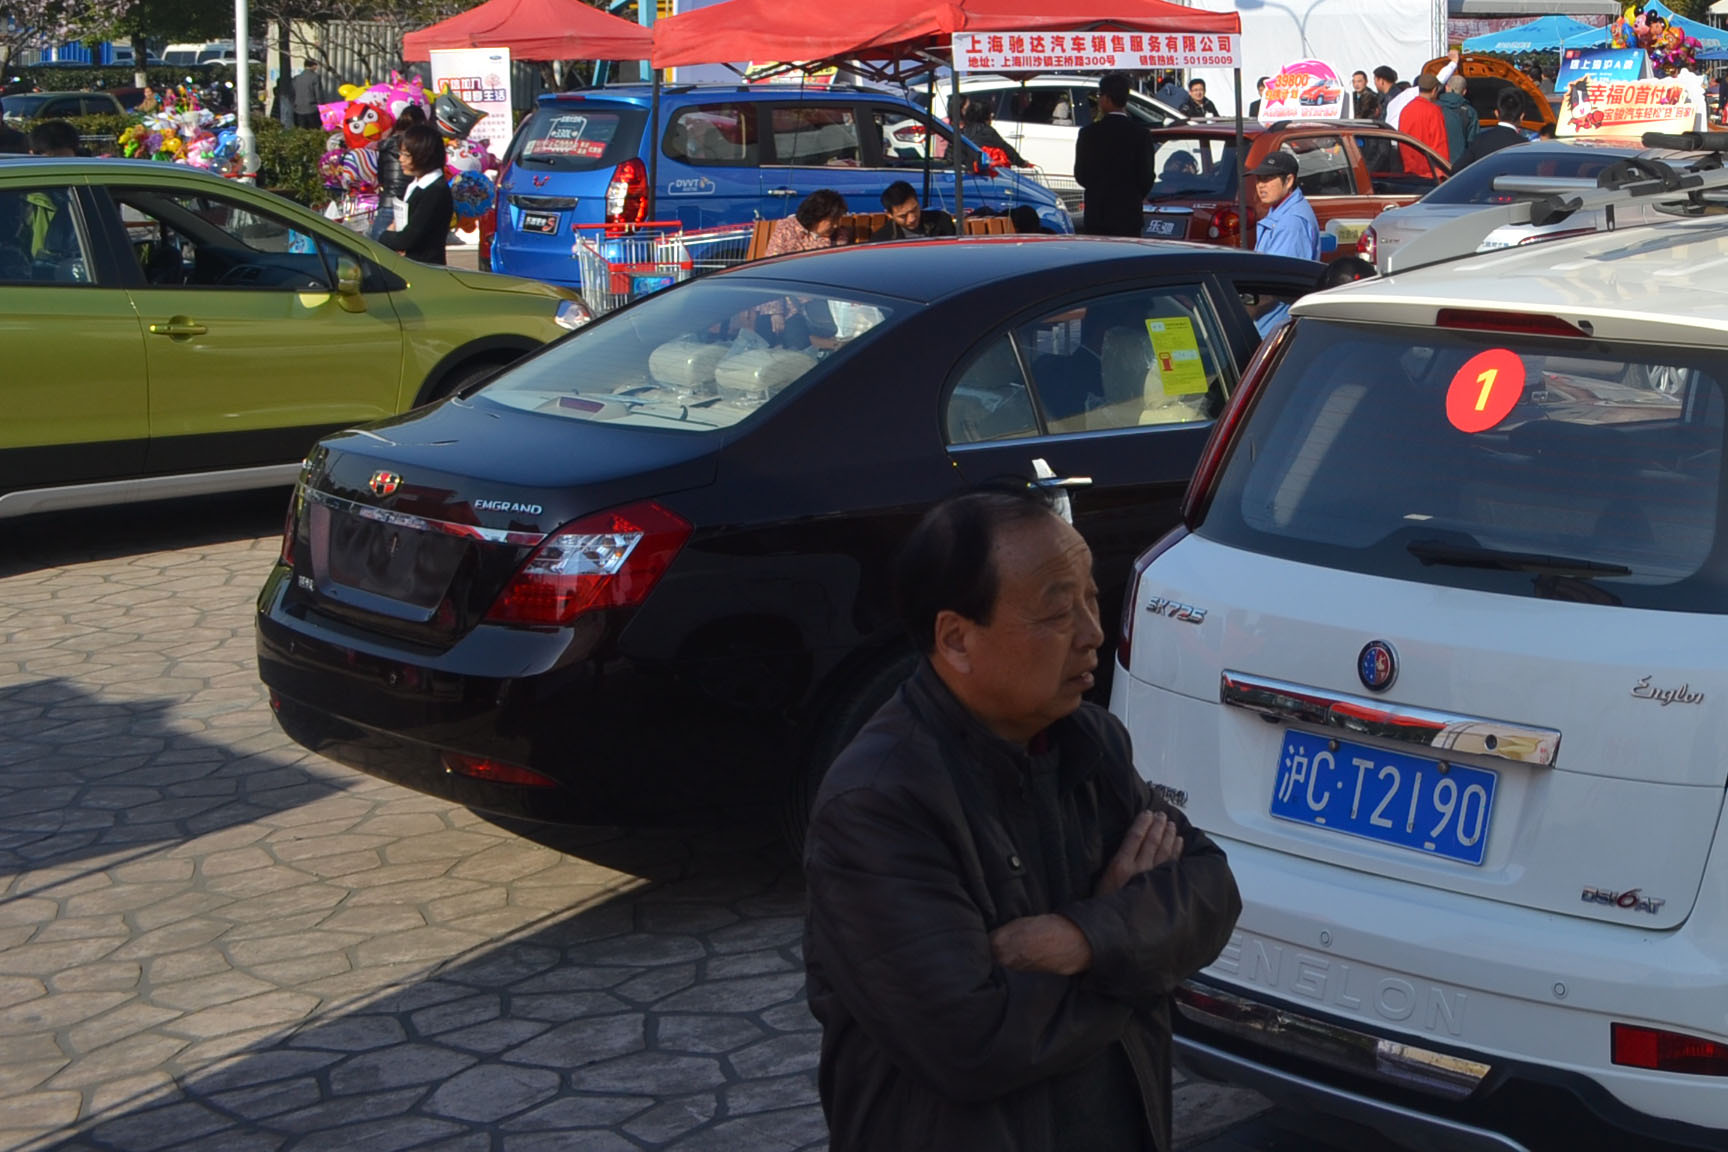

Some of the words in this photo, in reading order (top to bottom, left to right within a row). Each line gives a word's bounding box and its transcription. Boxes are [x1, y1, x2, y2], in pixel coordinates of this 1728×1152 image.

[1275, 73, 1309, 87] 39800
[1475, 369, 1498, 411] 1
[474, 499, 542, 515] EMGRAND
